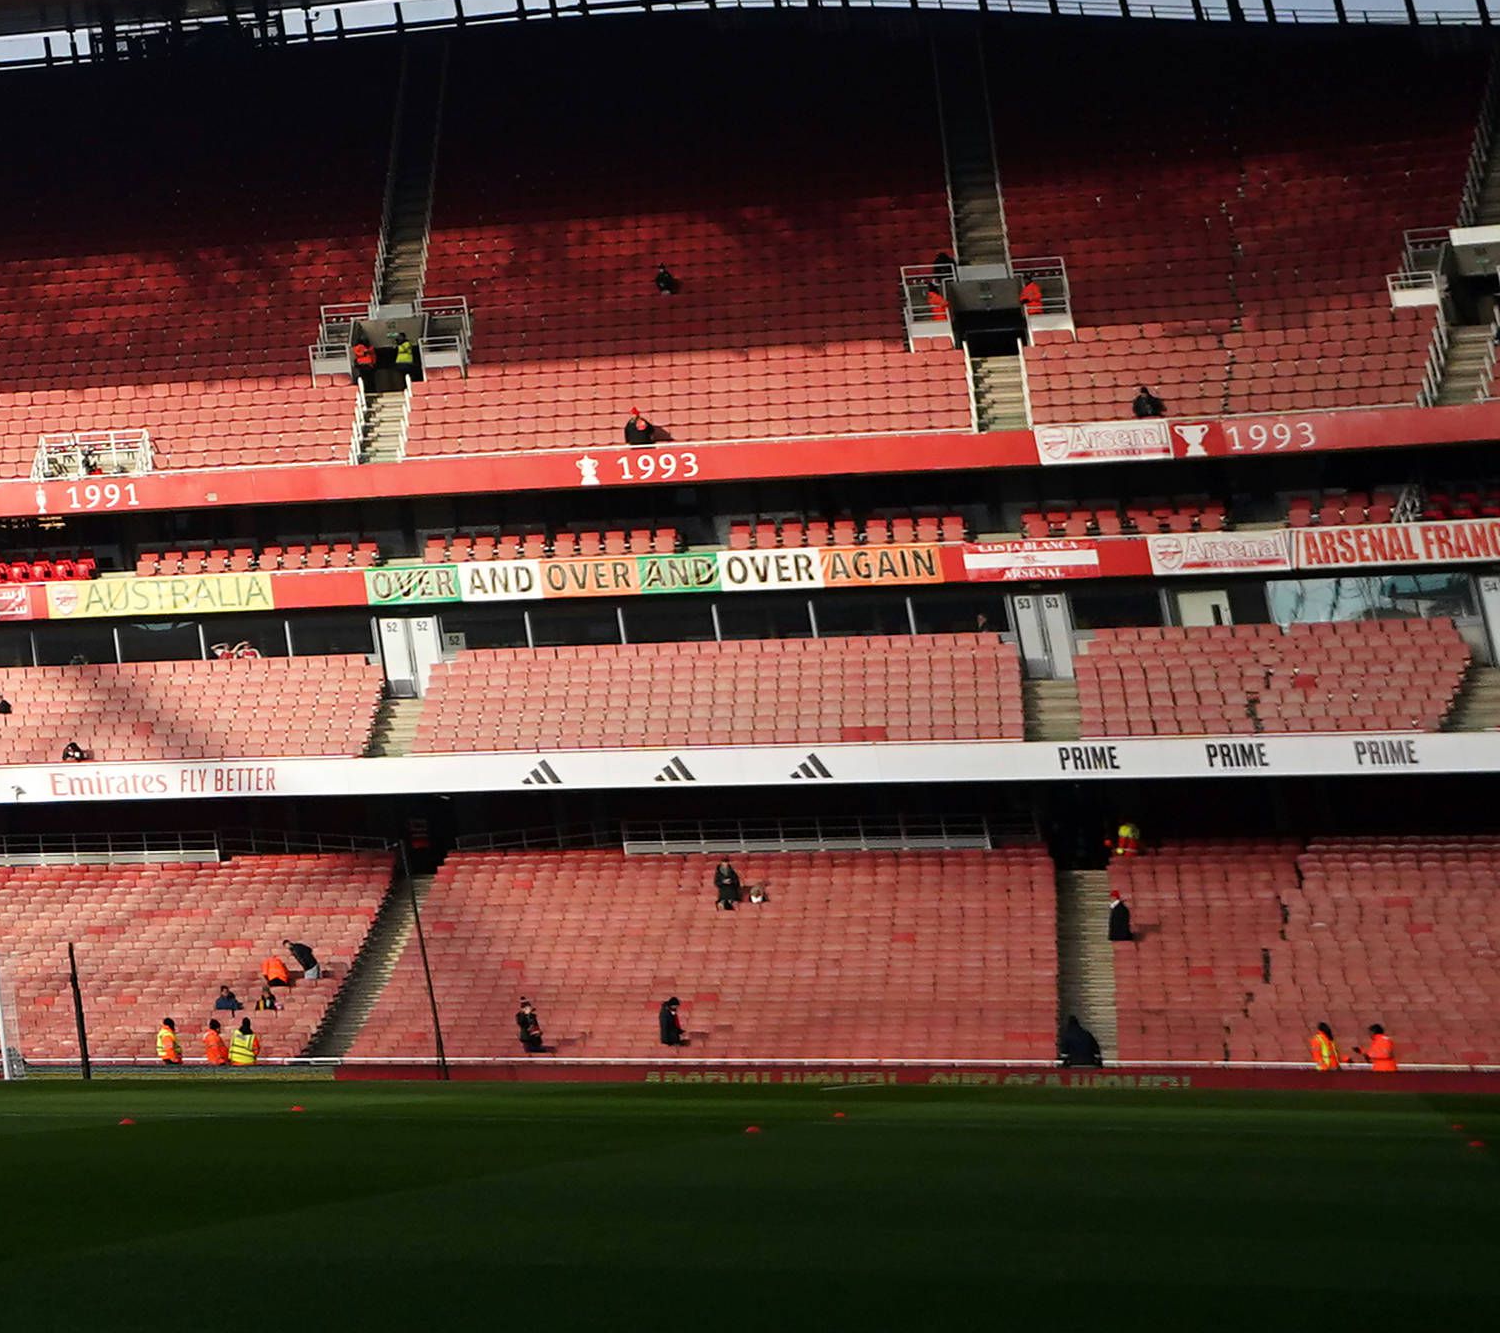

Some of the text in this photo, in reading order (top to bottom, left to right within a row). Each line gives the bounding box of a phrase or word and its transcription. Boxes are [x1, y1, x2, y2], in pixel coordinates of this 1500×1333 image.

[1069, 421, 1167, 449] Arsenal
[1225, 422, 1316, 451] 1993
[617, 452, 700, 480] 1993
[66, 482, 140, 509] 1991
[977, 540, 1078, 553] COSTA BLANCA
[1187, 529, 1285, 560] Arsenal
[1305, 527, 1419, 566] ARSENAL
[372, 549, 936, 599] OVER AND OVER AND OVER AGAIN
[1003, 567, 1066, 580] ARSENAL
[84, 576, 270, 613] AUSTRALIA
[1018, 598, 1031, 609] 53
[1045, 597, 1058, 608] 53
[386, 622, 398, 633] 52
[417, 621, 428, 632] 52
[449, 636, 461, 646] 52
[1058, 746, 1121, 771] PRIME
[1205, 743, 1270, 768] PRIME
[1354, 740, 1419, 765] PRIME
[49, 766, 276, 796] Emirates FLY BETTER
